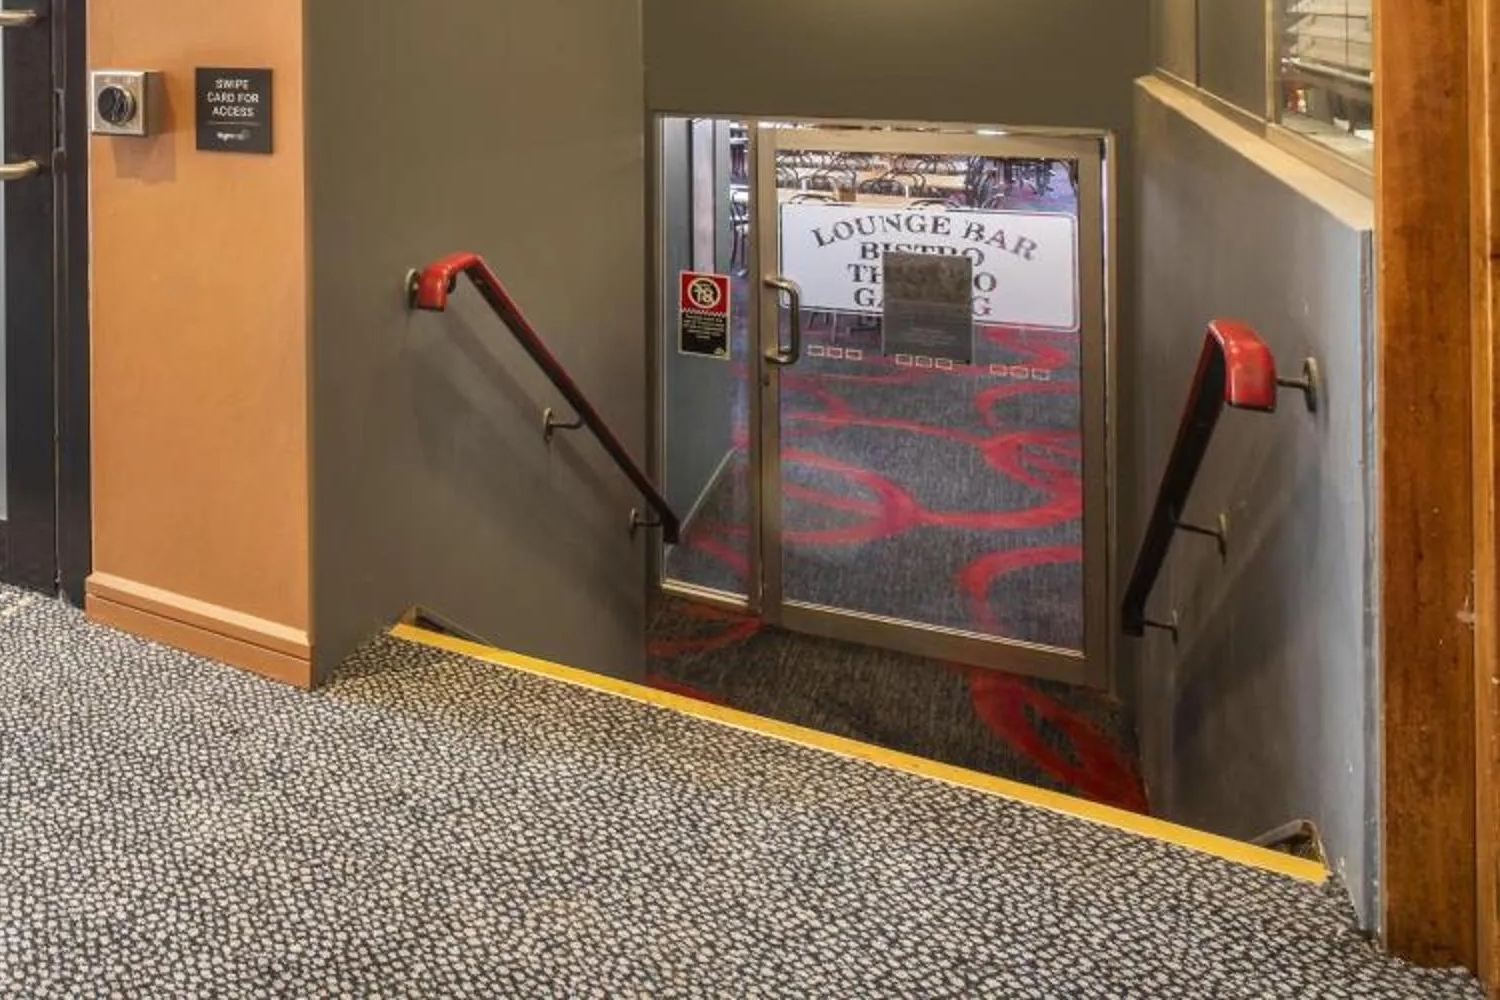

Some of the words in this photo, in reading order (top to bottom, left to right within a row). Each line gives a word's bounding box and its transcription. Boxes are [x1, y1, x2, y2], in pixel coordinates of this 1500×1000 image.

[215, 78, 249, 90] SWIPE
[206, 91, 235, 103] CARD
[237, 92, 260, 104] FOR
[211, 105, 255, 118] ACCESS
[811, 212, 952, 248] LOUNGE
[961, 219, 1039, 261] BAR
